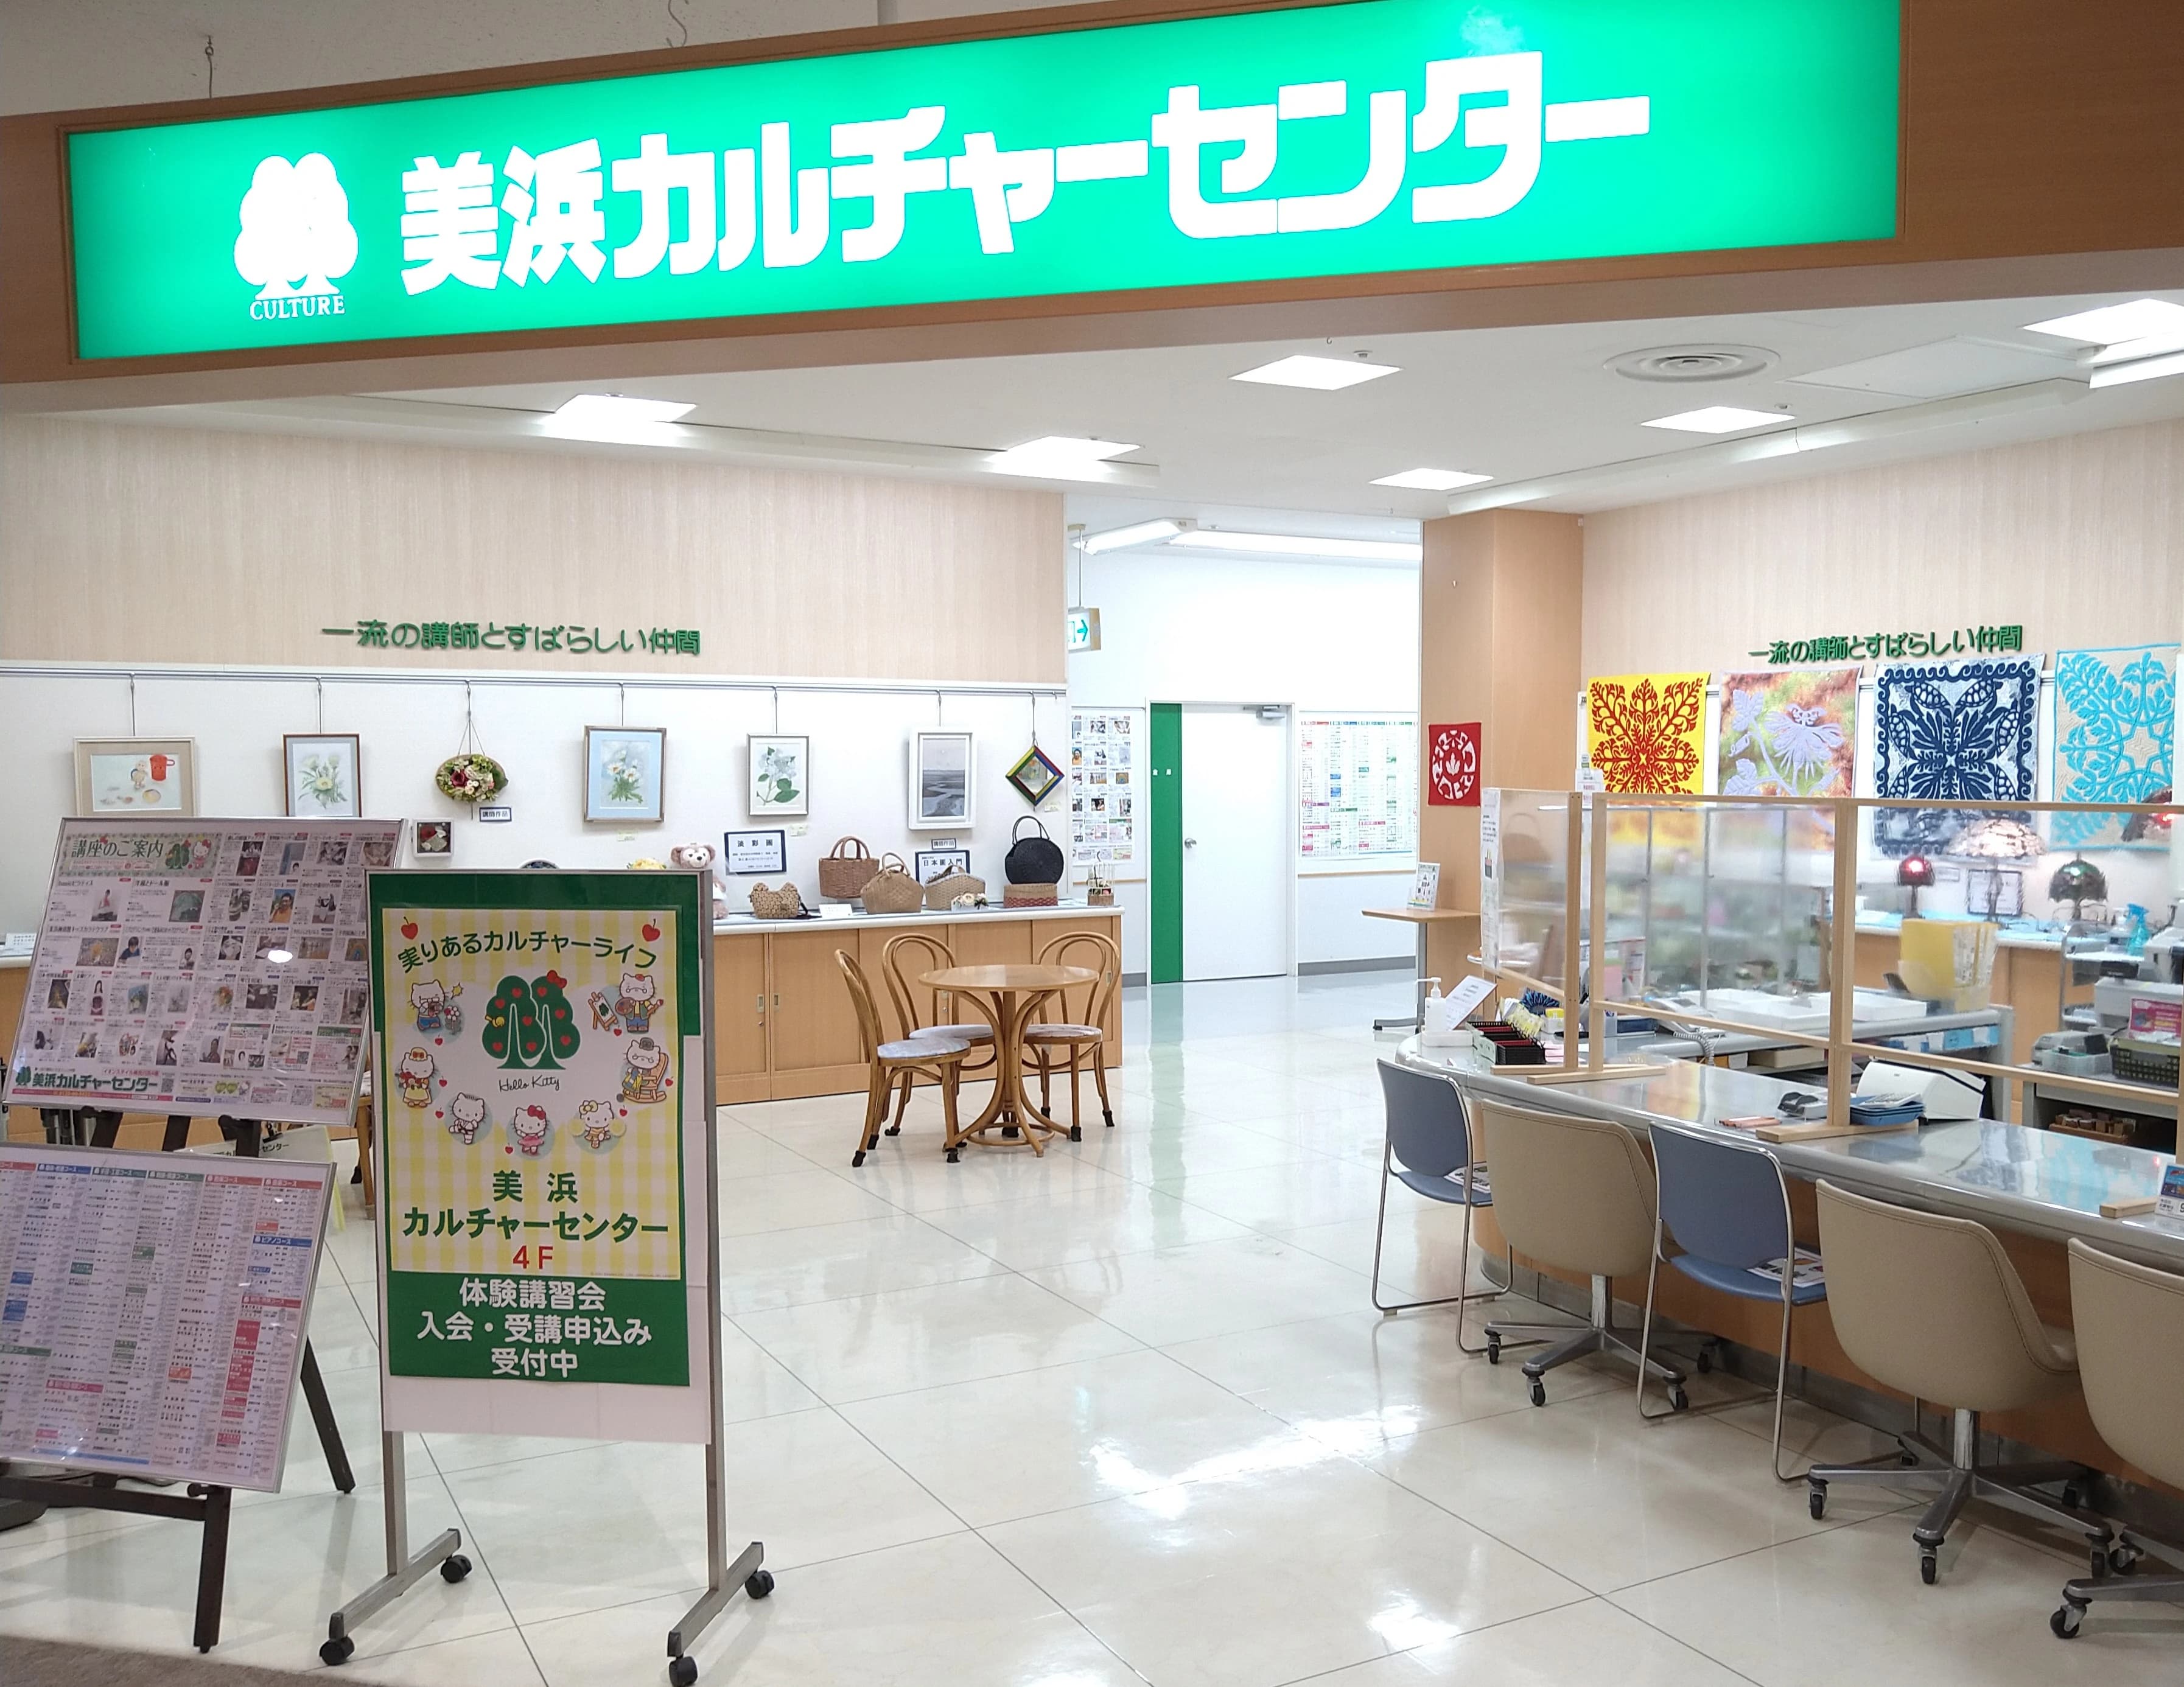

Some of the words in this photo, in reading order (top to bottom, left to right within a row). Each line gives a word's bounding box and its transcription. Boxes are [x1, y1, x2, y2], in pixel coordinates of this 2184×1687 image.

[402, 51, 1650, 296] 美浜カルチャーセンター
[250, 296, 345, 320] CULTURE
[322, 619, 701, 655] 一流の講師とすばらしい仲間
[1748, 624, 2023, 665] 一流の講師とすばらしい仲間
[71, 838, 164, 859] 講座のご案内
[397, 930, 658, 974] 実りあるカルチャーライフ
[32, 1072, 158, 1093] 美浜カルチャーセンター
[499, 1076, 529, 1092] Hello
[531, 1074, 561, 1092] Kitty
[492, 1170, 578, 1203] 美浜
[402, 1206, 669, 1243] カルチャーセンター
[513, 1245, 553, 1270] 4F
[459, 1277, 606, 1312] 体験講習会
[416, 1310, 652, 1346] 入会・受講申込み
[491, 1347, 578, 1378] 受付中
